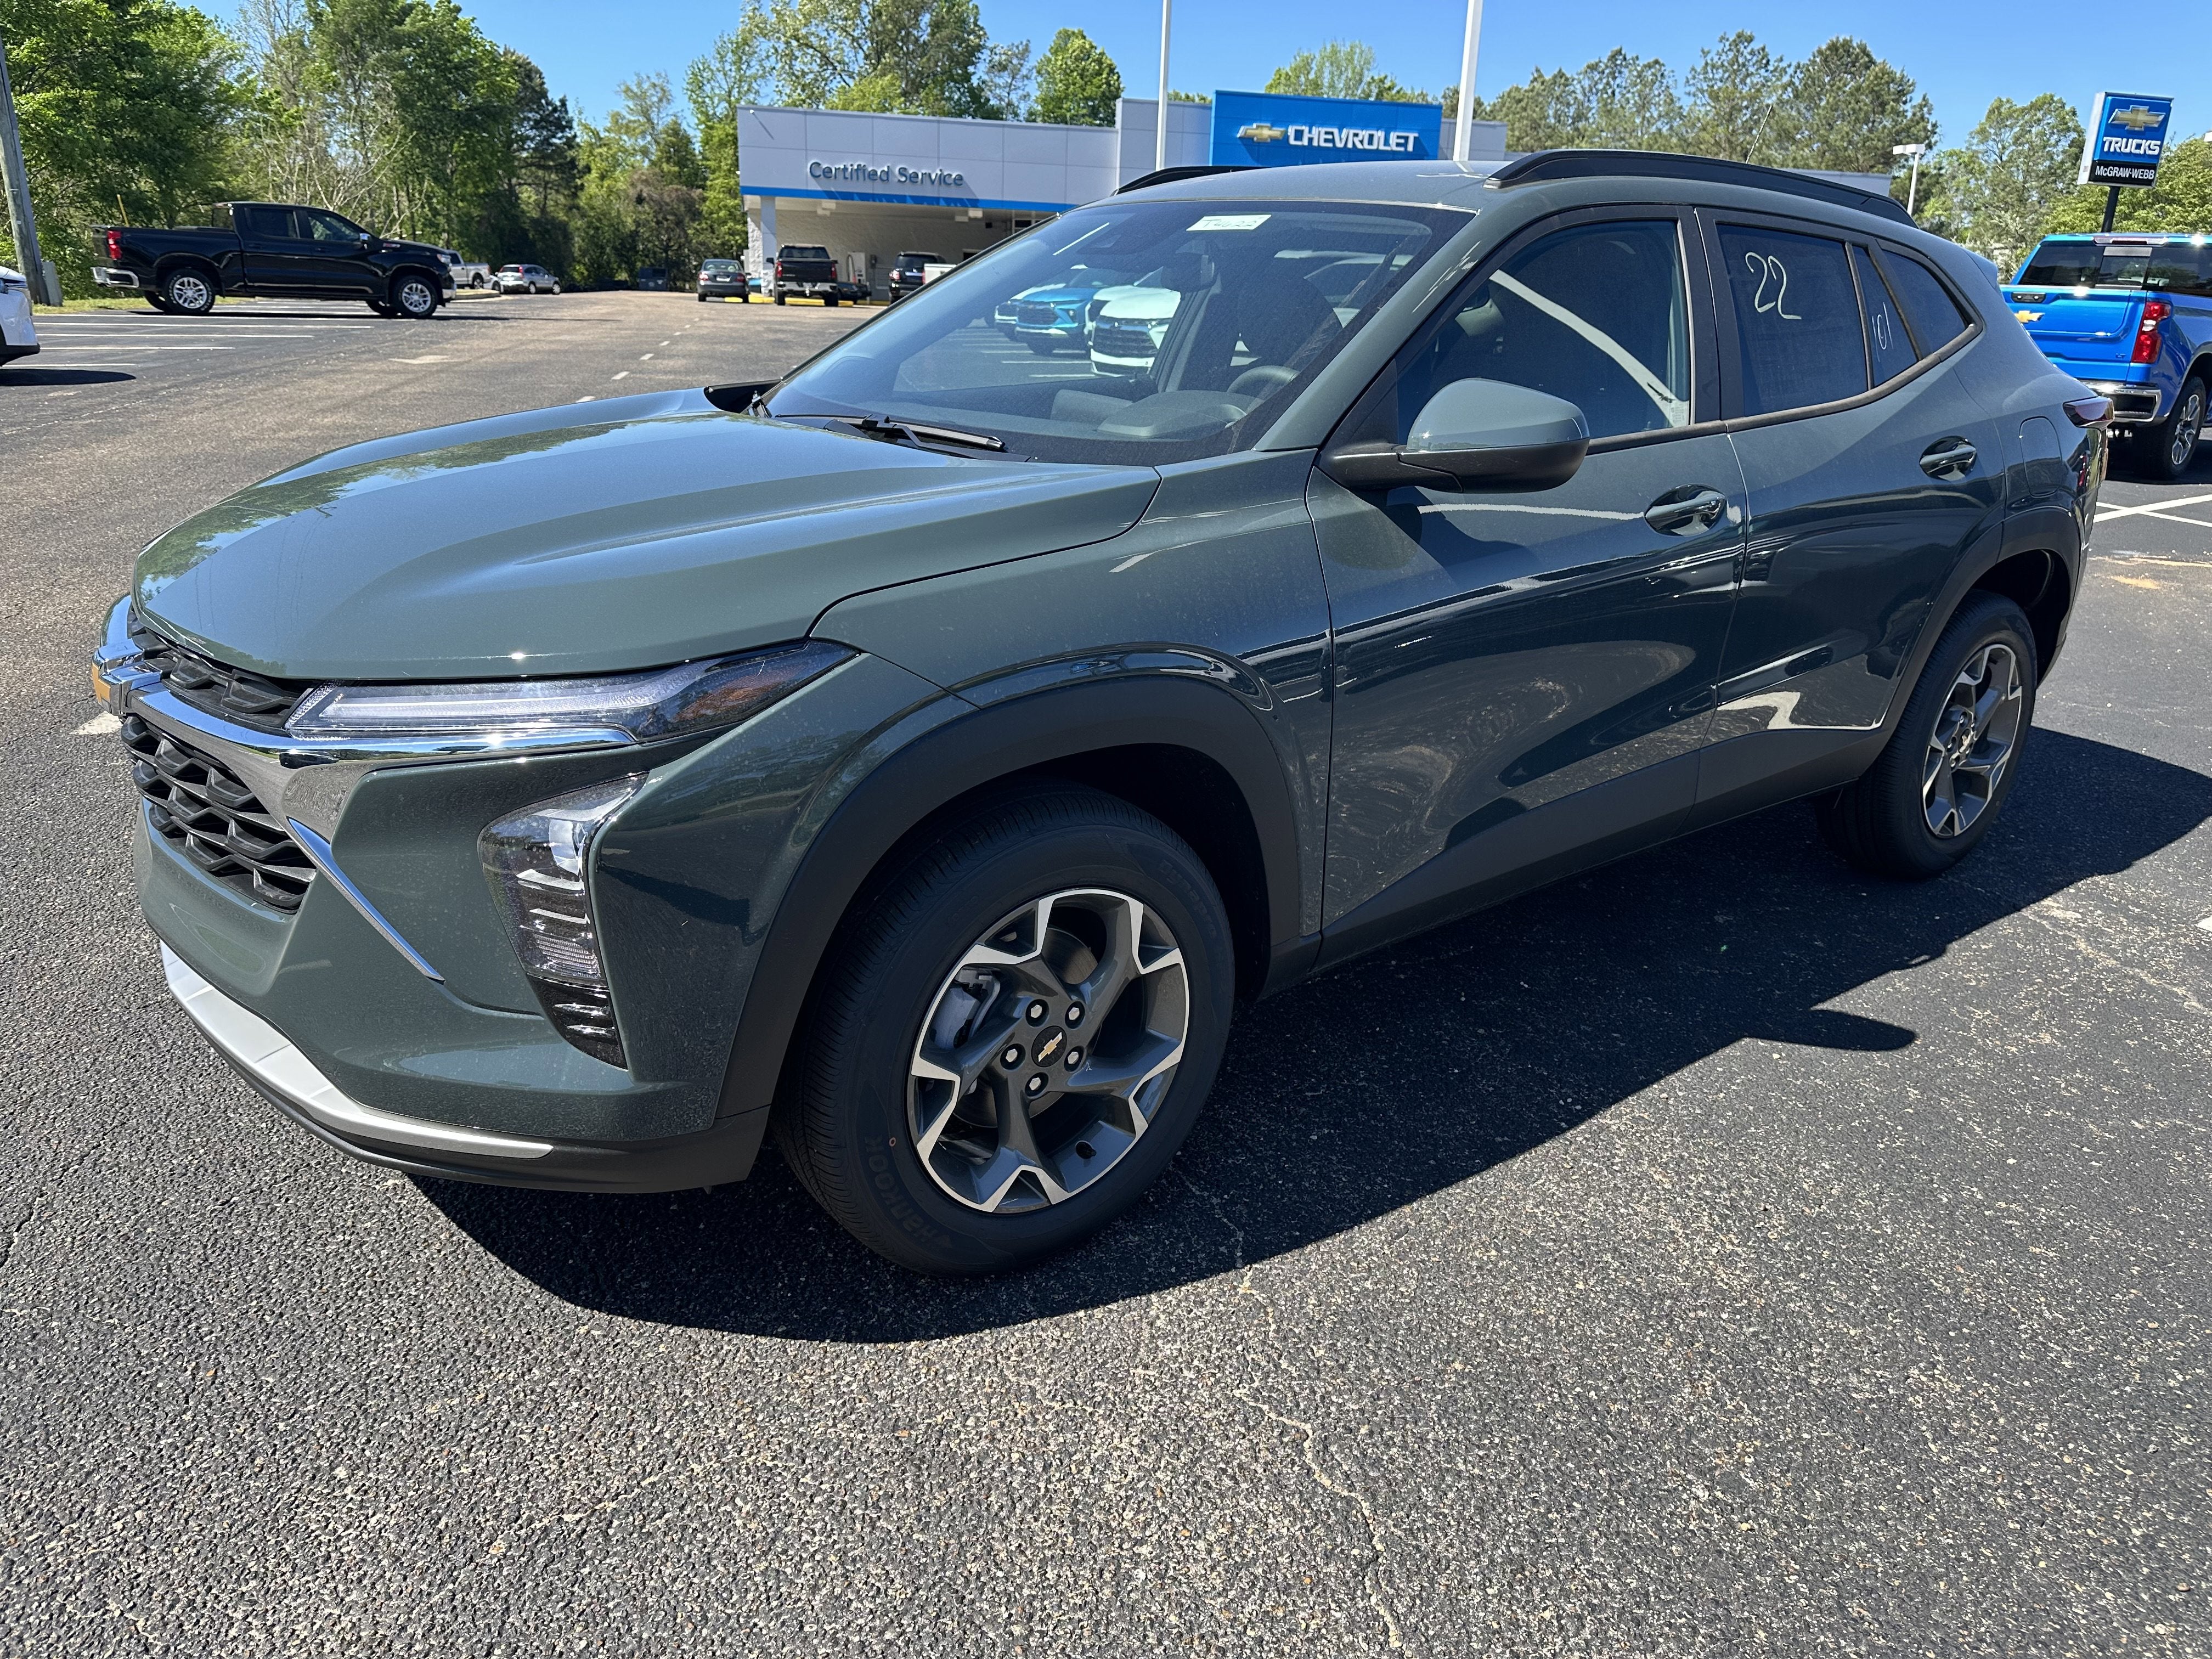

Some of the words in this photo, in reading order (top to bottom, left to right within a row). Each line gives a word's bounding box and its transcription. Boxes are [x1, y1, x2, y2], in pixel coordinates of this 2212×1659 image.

[1288, 125, 1419, 152] CHEVROLET
[2103, 137, 2161, 155] TRUCKS
[809, 161, 890, 182] Certified
[897, 167, 964, 187] Service
[2095, 165, 2155, 180] McGRAW-WEBB
[1745, 252, 1802, 320] 22
